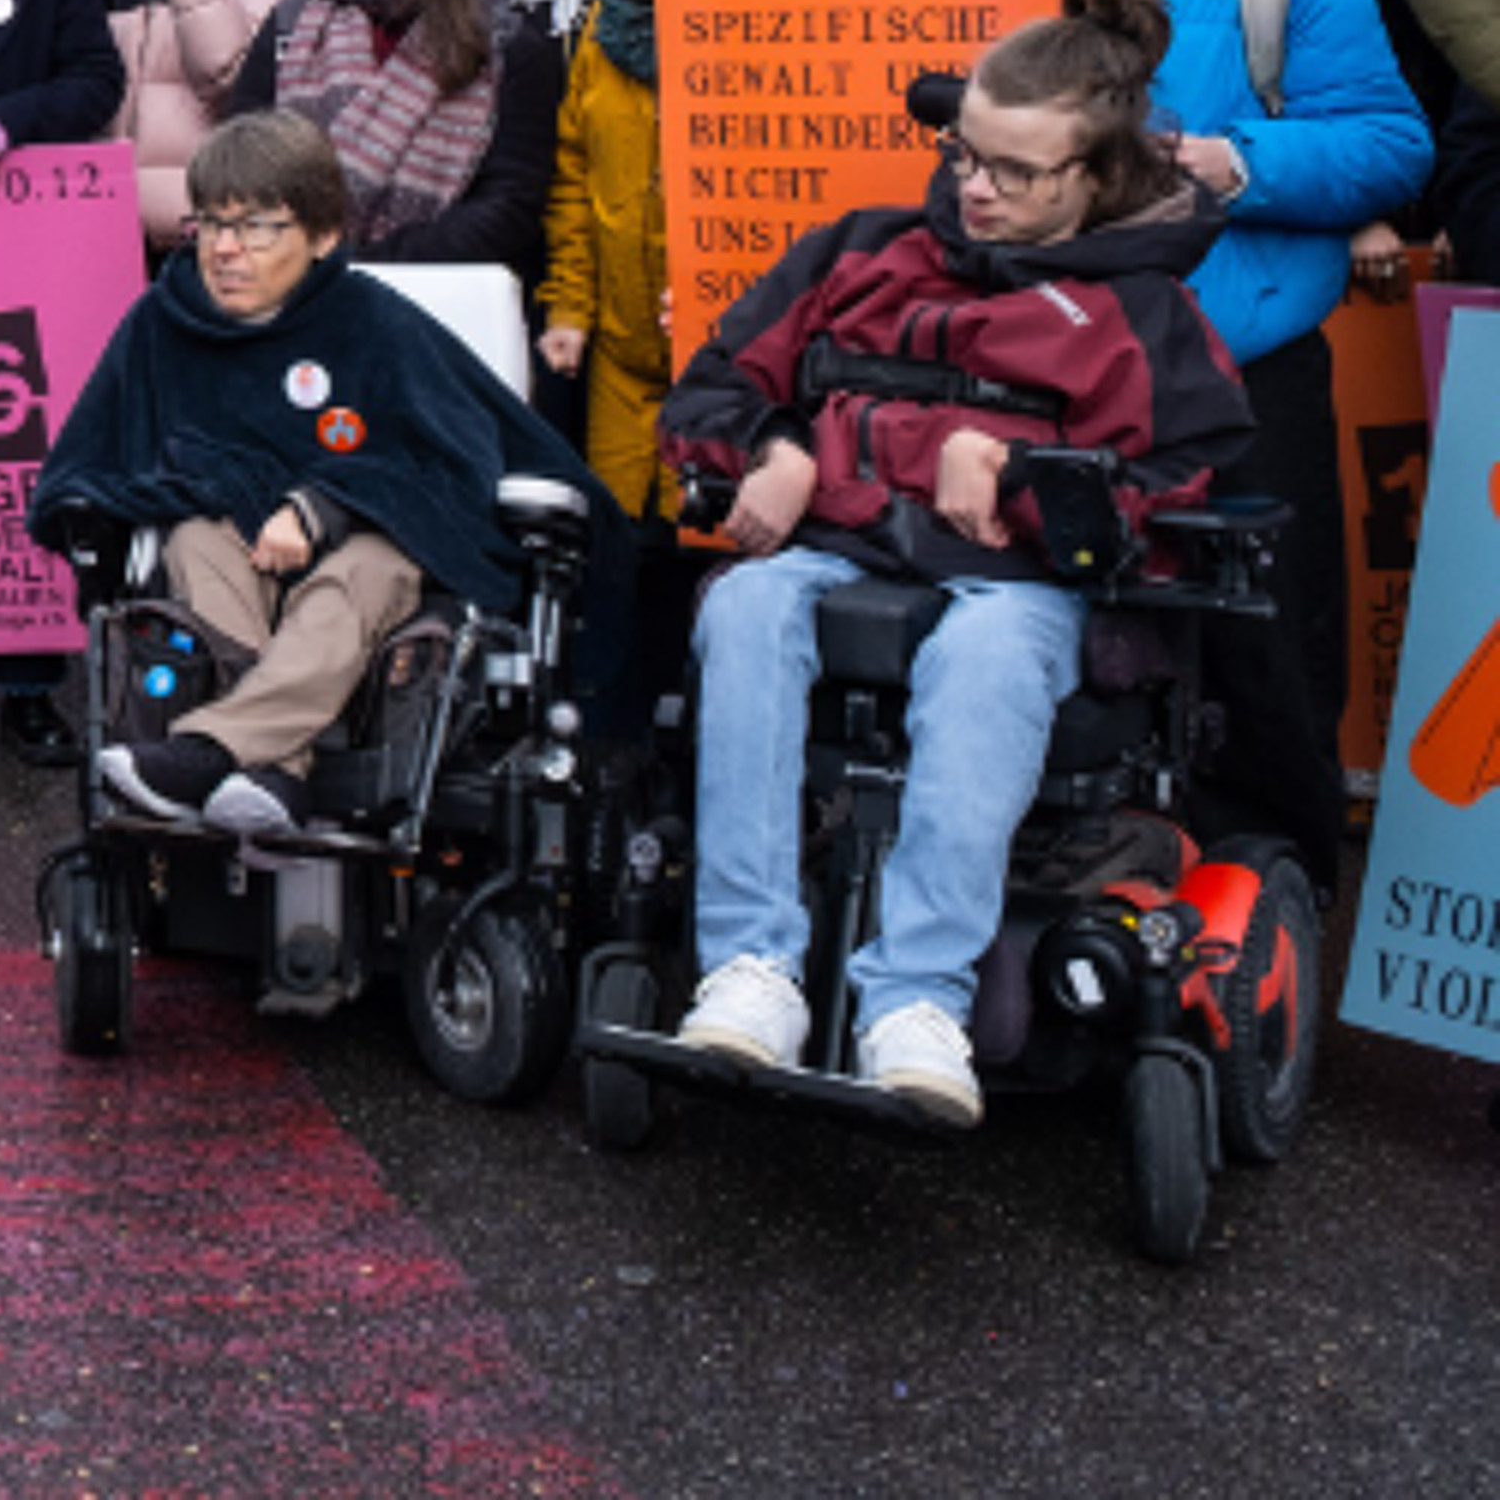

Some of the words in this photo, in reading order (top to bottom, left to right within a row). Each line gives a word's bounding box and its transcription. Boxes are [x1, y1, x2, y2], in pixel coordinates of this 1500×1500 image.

[683, 6, 1000, 44] SPEZIFISCHE
[684, 61, 852, 98] GEWALT
[690, 166, 830, 201] NICHT
[692, 215, 802, 252] UNSI
